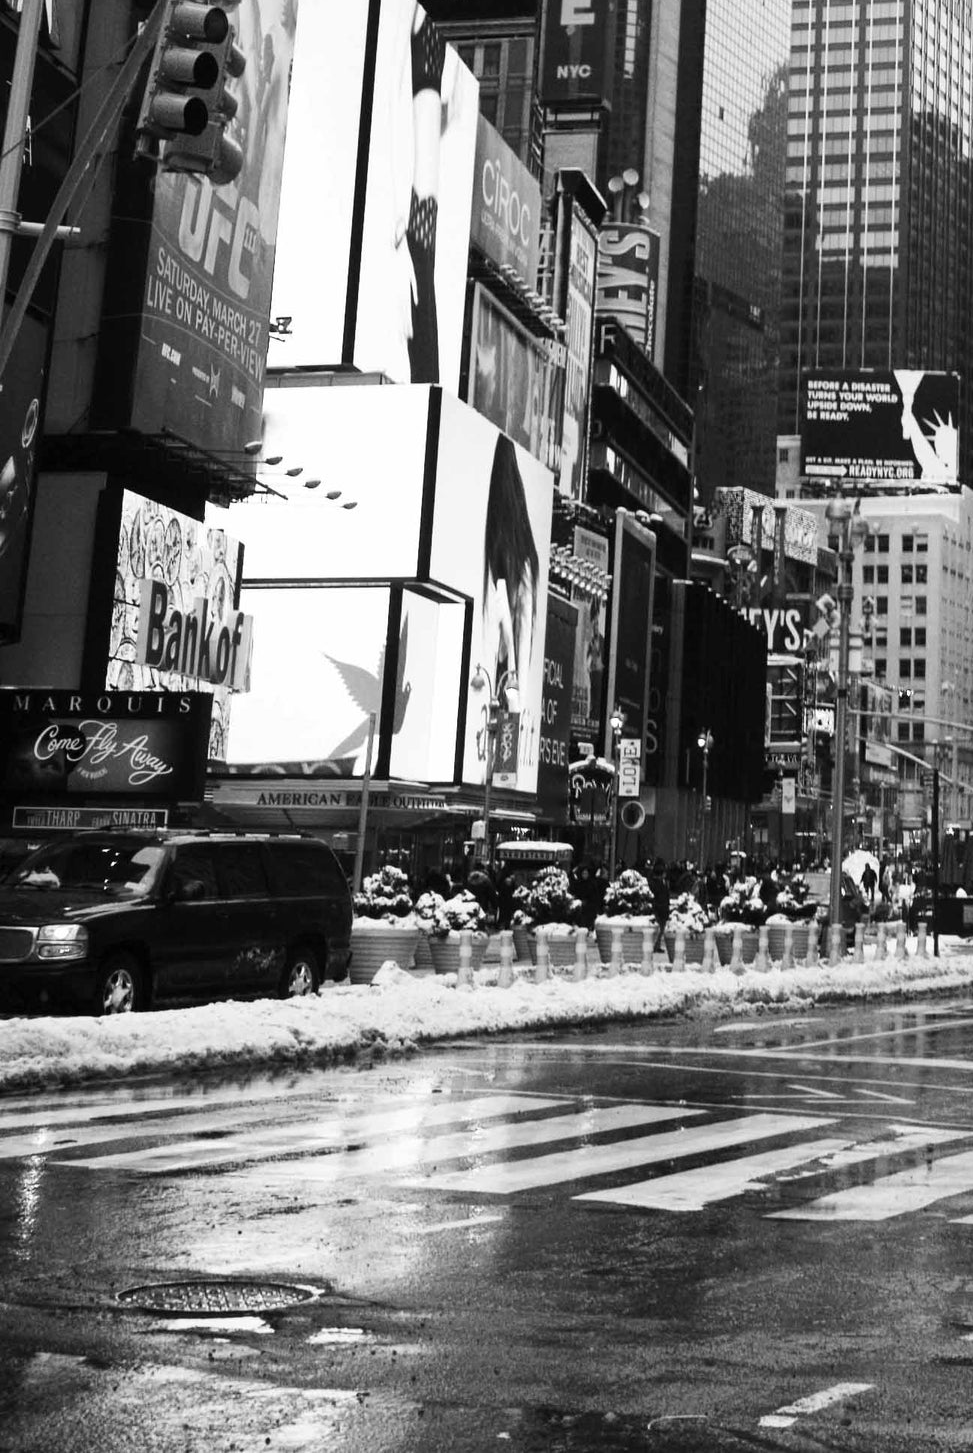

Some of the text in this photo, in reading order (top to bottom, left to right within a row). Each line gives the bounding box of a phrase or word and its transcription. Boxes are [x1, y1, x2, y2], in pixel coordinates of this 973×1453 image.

[556, 64, 592, 80] NYC
[146, 274, 173, 315] LIVE
[176, 297, 192, 325] ON
[195, 309, 264, 382] PAY-PER-VIEW
[212, 299, 248, 340] MARCH
[247, 319, 262, 347] 27
[807, 380, 891, 393] BEFORE A DISASTER
[807, 391, 898, 404] TURNS YOUR WORLD
[807, 401, 838, 411] UPSIDE
[806, 410, 818, 420] BE
[144, 581, 246, 688] Bank of
[13, 696, 192, 713] MARQUIS
[33, 719, 173, 785] Come Fly Away
[256, 792, 342, 807] AMERICAN
[46, 810, 81, 827] THARP
[112, 811, 157, 826] SINATRA
